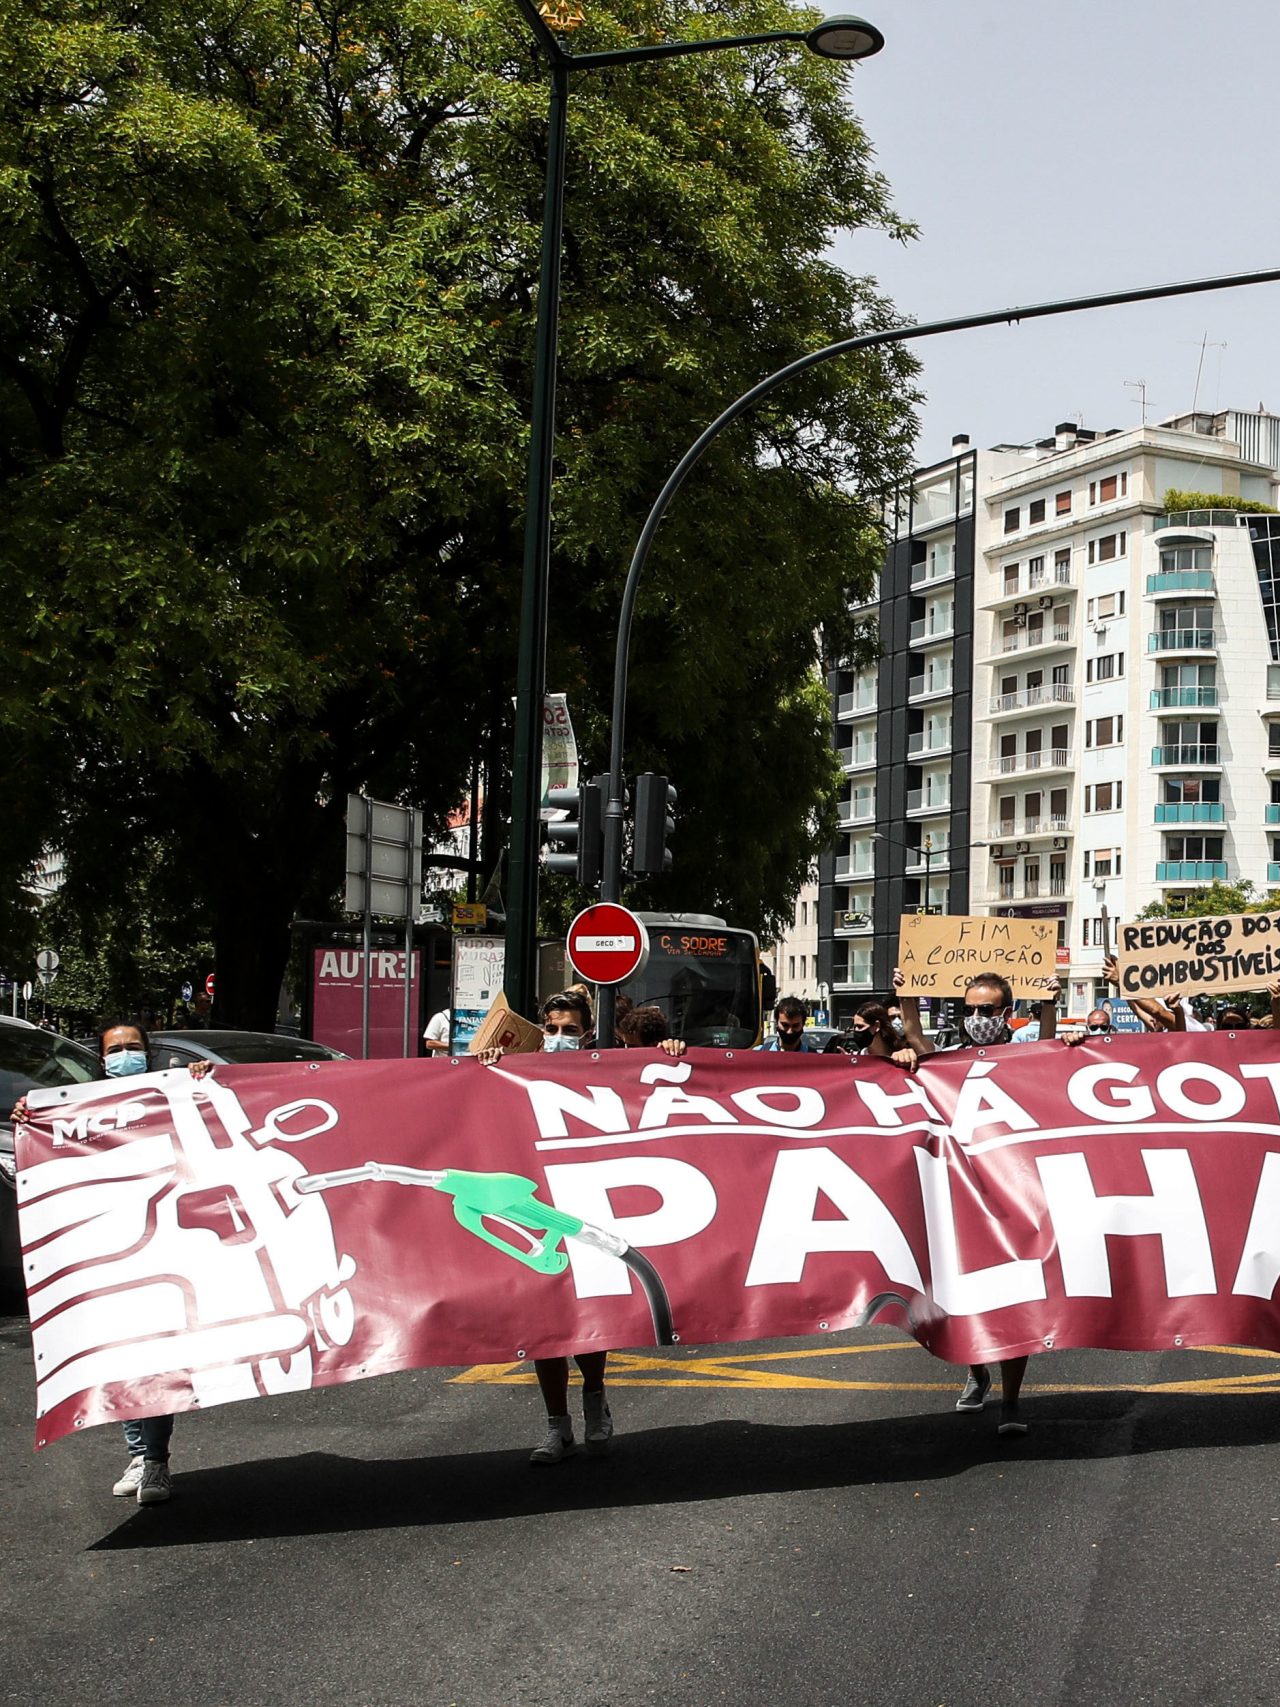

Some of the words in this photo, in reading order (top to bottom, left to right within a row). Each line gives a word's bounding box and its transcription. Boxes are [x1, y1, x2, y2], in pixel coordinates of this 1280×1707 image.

[680, 936, 728, 952] SODRE
[1123, 919, 1232, 951] REDUÇÃO
[902, 941, 916, 963] À
[926, 943, 1043, 966] CORRUPÇÃO
[1195, 939, 1226, 956] DOS
[911, 973, 938, 988] NOS
[1116, 1014, 1139, 1023] CERTA
[526, 1061, 825, 1138] NÃO
[856, 1060, 1040, 1144] HÁ
[52, 1102, 147, 1145] MCP
